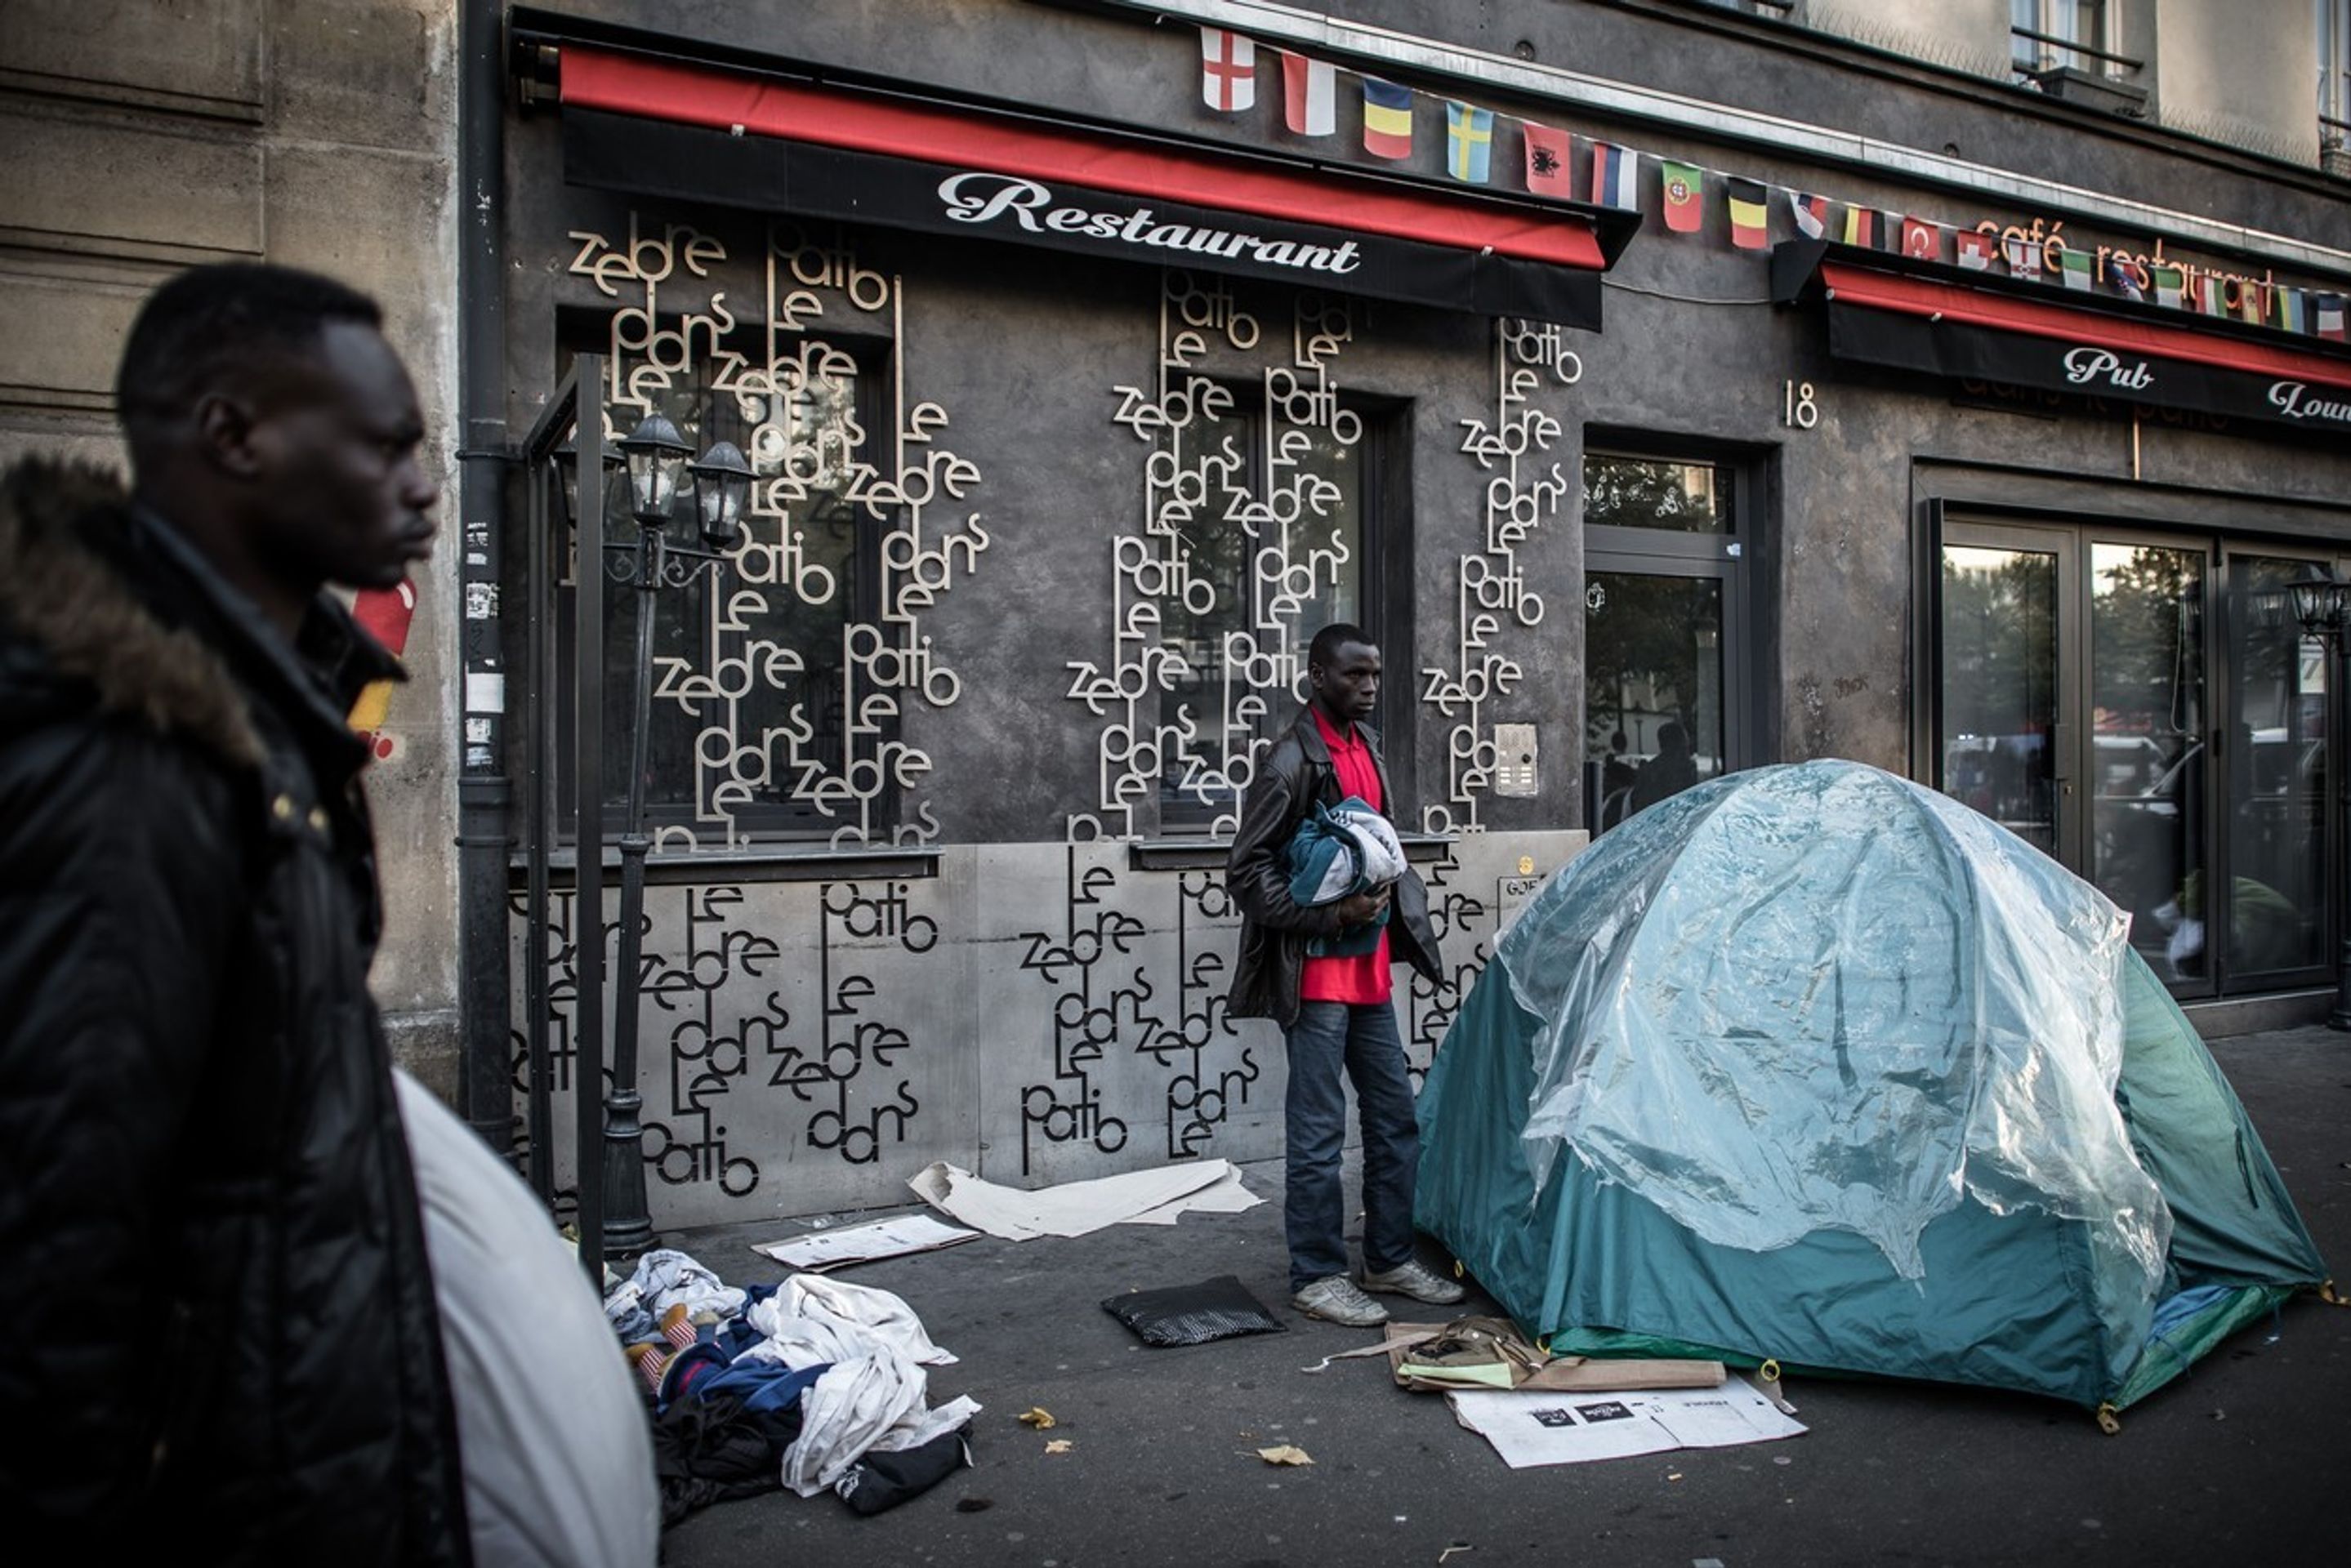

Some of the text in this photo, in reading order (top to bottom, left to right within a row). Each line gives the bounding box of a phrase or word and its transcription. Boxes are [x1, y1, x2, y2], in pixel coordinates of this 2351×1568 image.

[938, 172, 1361, 274] Restaurant
[2097, 238, 2272, 317] rstauat
[2063, 347, 2155, 390] Pub
[1786, 379, 1818, 429] 18
